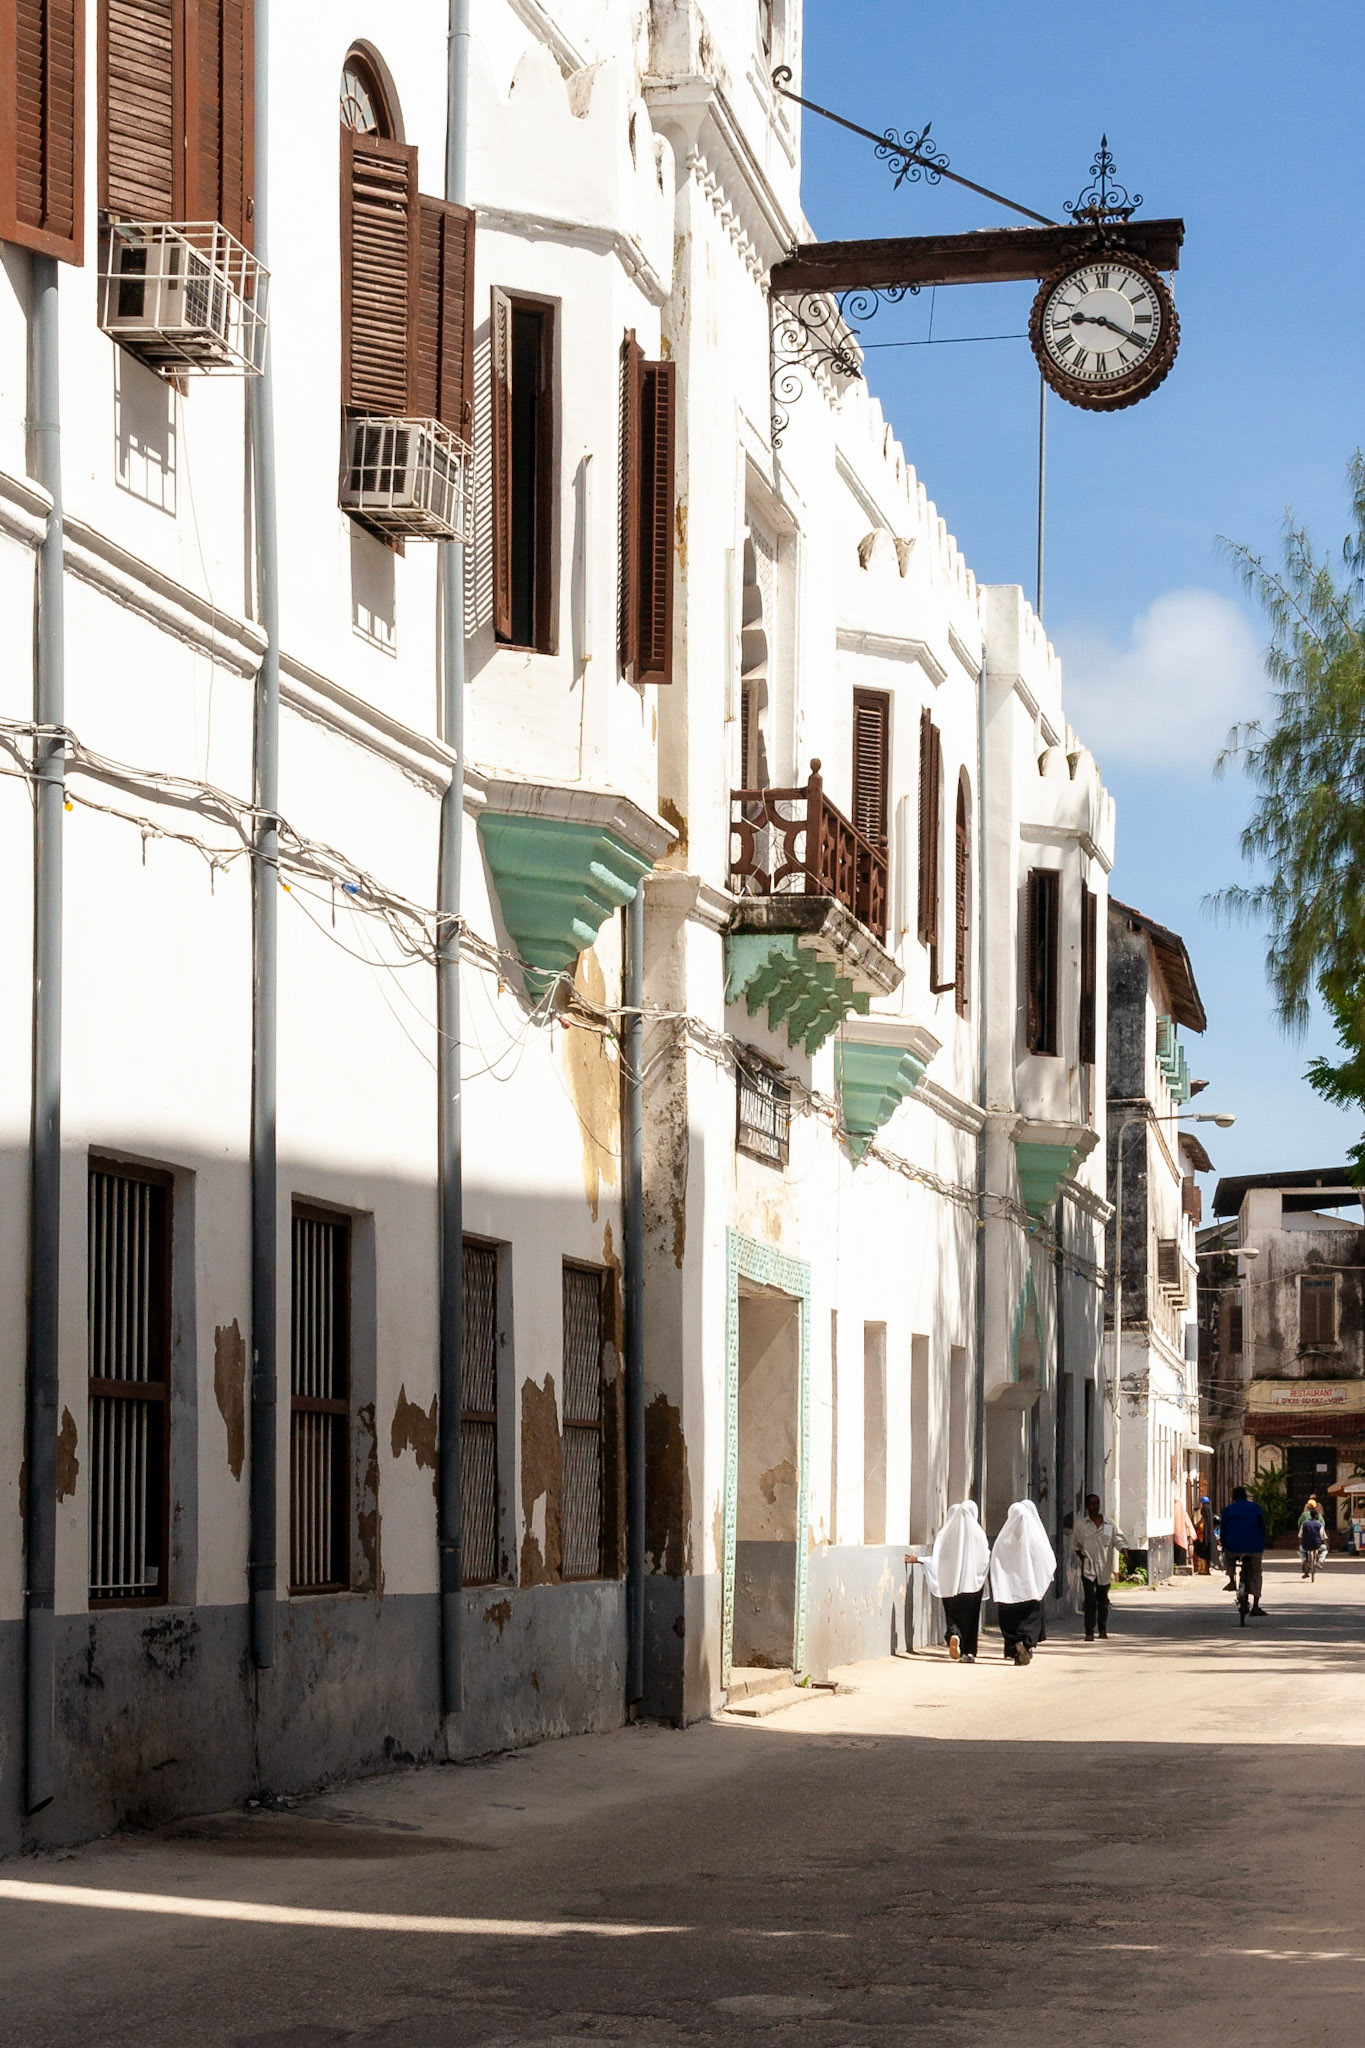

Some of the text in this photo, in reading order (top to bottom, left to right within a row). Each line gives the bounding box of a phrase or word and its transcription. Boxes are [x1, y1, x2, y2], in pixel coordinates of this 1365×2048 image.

[1095, 272, 1109, 289] XII
[1118, 277, 1129, 291] I
[1073, 279, 1088, 298] XI
[1058, 297, 1075, 311] X
[1129, 292, 1146, 304] II
[1052, 316, 1070, 330] IX
[1135, 315, 1152, 324] III
[1056, 333, 1076, 355] VIII
[1072, 348, 1089, 370] VII
[1096, 353, 1107, 372] VI
[1118, 347, 1130, 365] V
[1290, 1389, 1333, 1397] RESTAURANT
